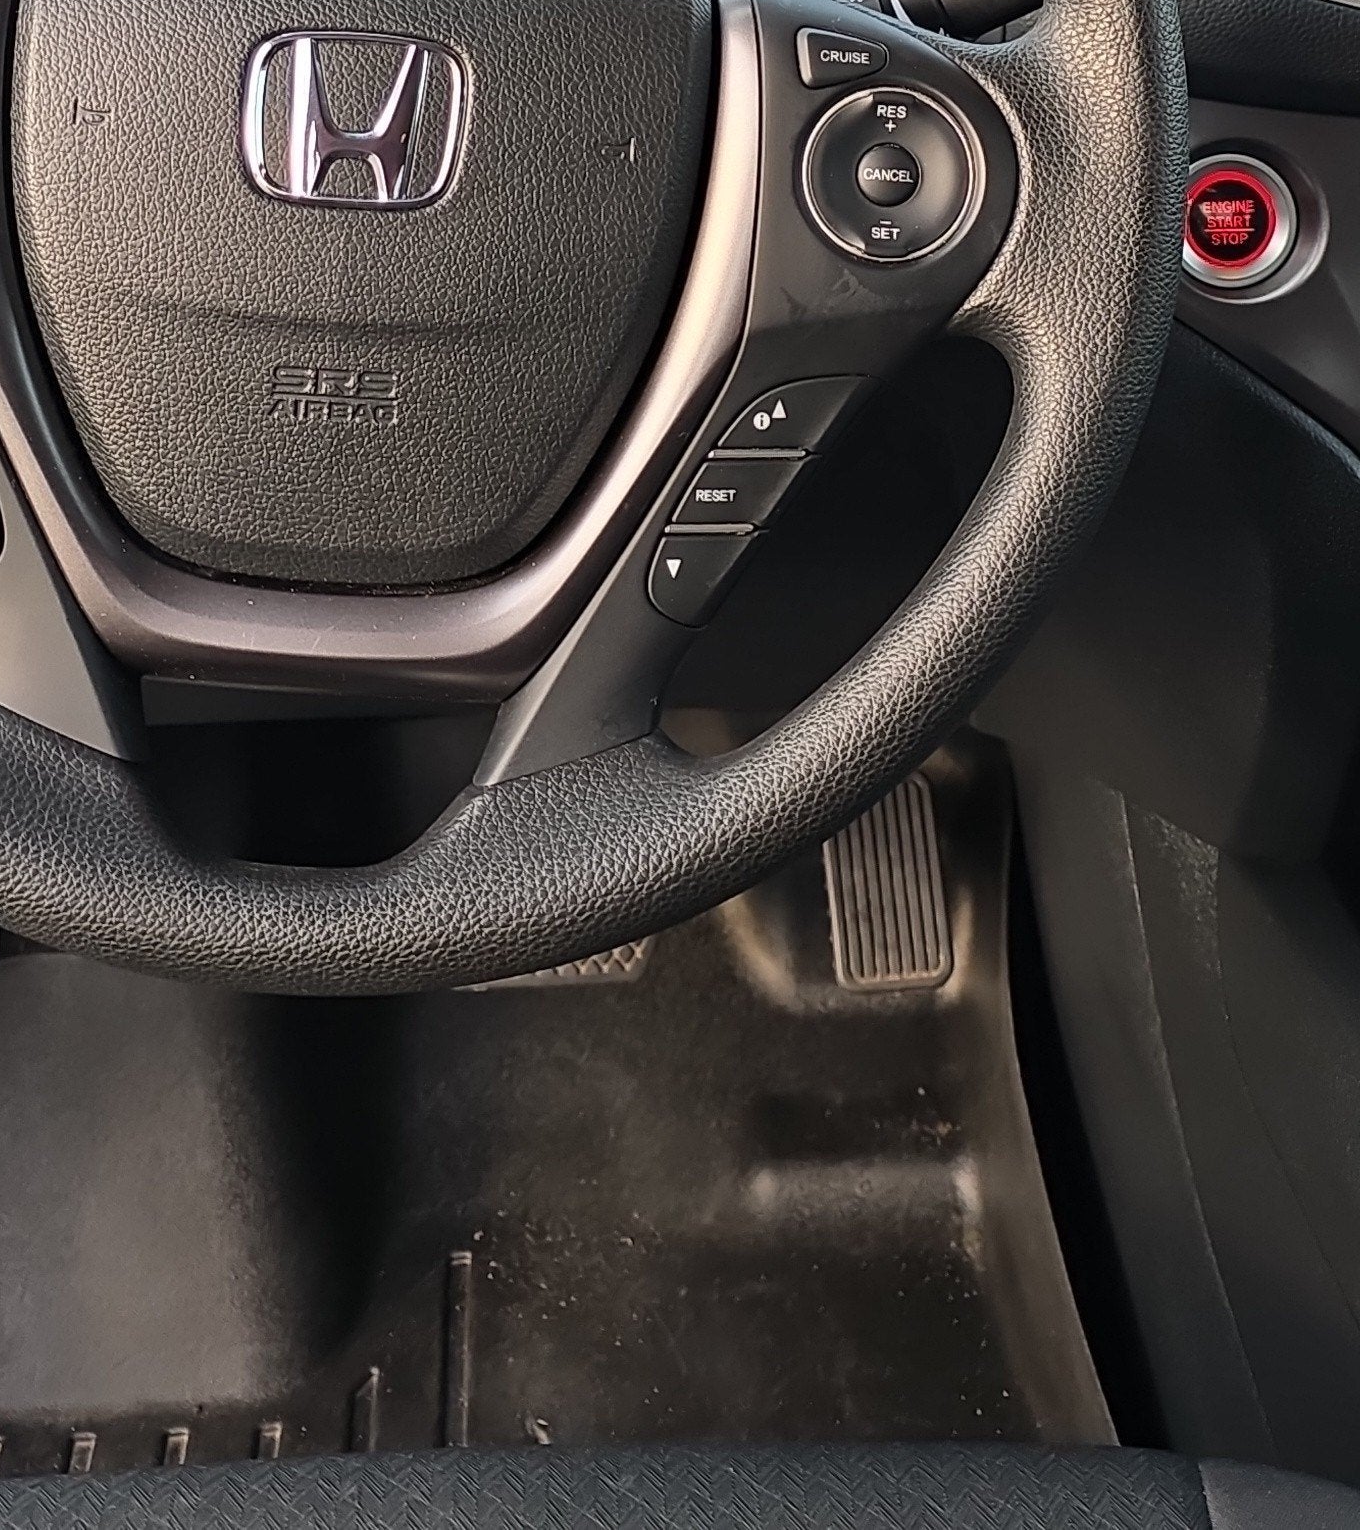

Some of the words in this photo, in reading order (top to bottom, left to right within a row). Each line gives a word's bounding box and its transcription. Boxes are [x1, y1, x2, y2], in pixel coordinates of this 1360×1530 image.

[820, 49, 871, 65] CRUISE
[876, 104, 907, 119] RES
[863, 168, 914, 183] CANCEL
[1202, 200, 1255, 213] ENGINE
[1207, 215, 1252, 228] START
[871, 227, 900, 241] SET
[1211, 233, 1249, 245] STOP
[271, 367, 398, 398] SRS
[268, 399, 398, 424] AIRBAG
[695, 489, 736, 502] RESET
